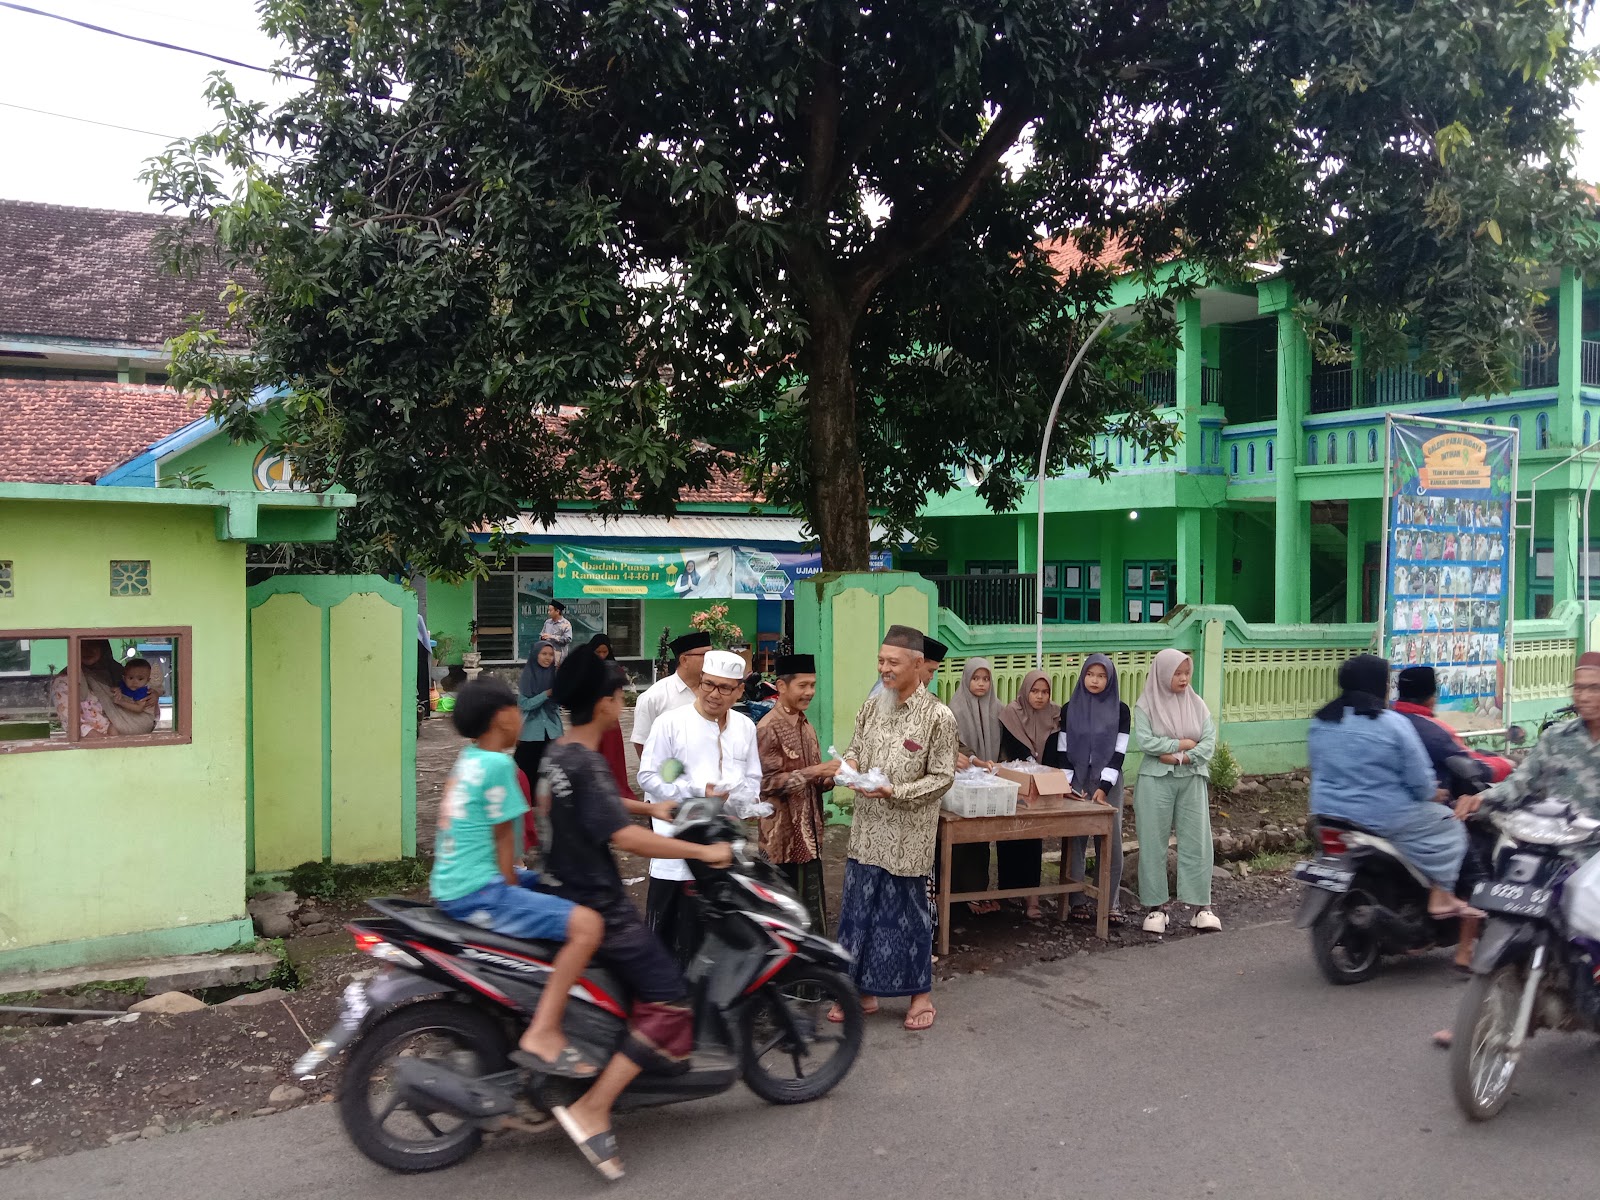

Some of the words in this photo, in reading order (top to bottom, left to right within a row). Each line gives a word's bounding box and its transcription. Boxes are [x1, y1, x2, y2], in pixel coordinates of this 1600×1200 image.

[581, 561, 618, 571] Ibadah
[620, 563, 650, 571] Puasa
[796, 567, 819, 575] UJIAN
[571, 570, 620, 580] Ramadan
[622, 572, 649, 580] 1446
[651, 572, 659, 580] H
